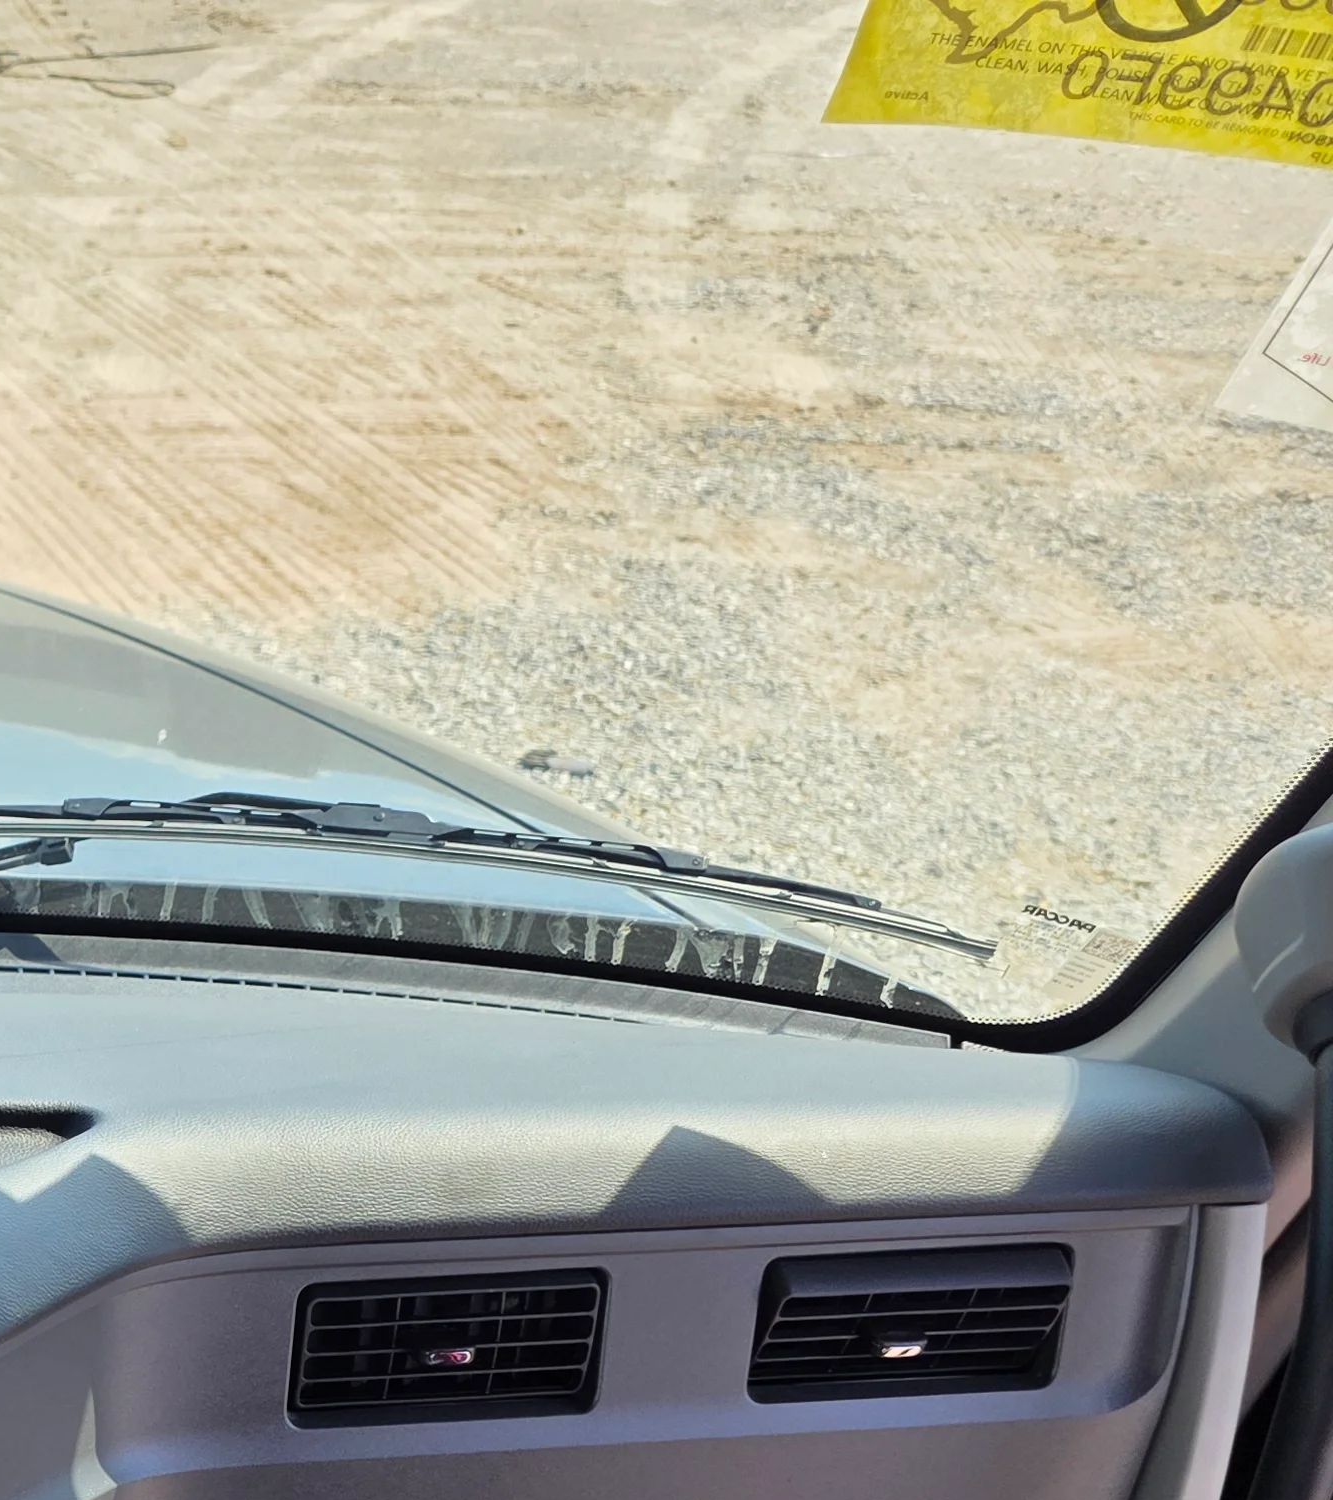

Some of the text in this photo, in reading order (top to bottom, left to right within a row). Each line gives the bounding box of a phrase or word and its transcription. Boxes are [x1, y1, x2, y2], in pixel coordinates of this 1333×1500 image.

[930, 32, 961, 46] THE
[965, 35, 1033, 52] ENAMEL
[1038, 41, 1065, 55] ON
[1070, 44, 1106, 58] THIS
[1109, 47, 1178, 65] VEHICLE
[1201, 57, 1238, 73] NOT
[1242, 60, 1290, 78] HARD
[1294, 67, 1328, 82] YET
[975, 56, 1030, 74] CLEAN,
[1036, 61, 1089, 78] WASH,
[1082, 85, 1135, 102] CLEAN
[1128, 110, 1153, 122] THIS
[1154, 113, 1185, 126] CARD
[1188, 117, 1203, 128] TO
